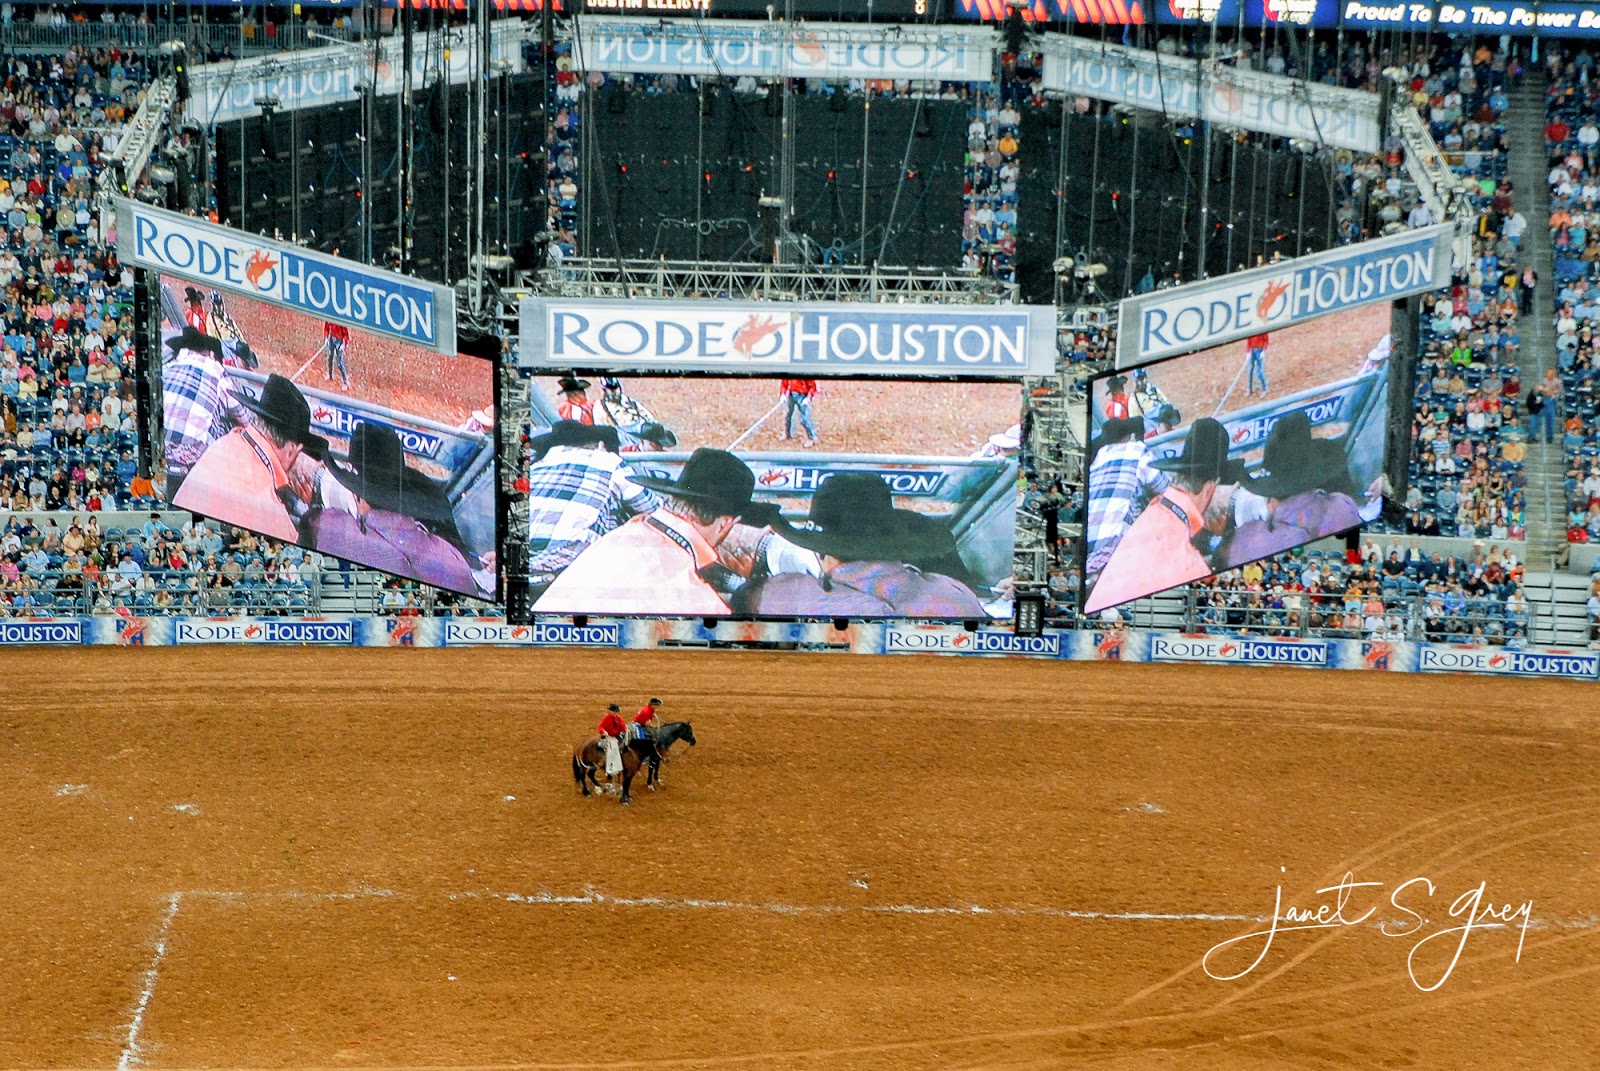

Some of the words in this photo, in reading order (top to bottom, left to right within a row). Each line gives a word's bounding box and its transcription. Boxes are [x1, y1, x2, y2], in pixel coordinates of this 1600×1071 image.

[1345, 2, 1405, 21] Proud
[1408, 4, 1432, 22] To
[1438, 6, 1466, 24] Be
[1471, 6, 1507, 25] The
[1509, 7, 1576, 27] Power
[1292, 248, 1434, 316] HOUSTON
[281, 254, 433, 339] HOUSTON
[794, 315, 1024, 363] HOUSTON
[266, 623, 350, 641] HOUSTON
[533, 624, 617, 643] HOUSTON
[973, 632, 1057, 653] HOUSTON
[1240, 642, 1324, 663] HOUSTON
[1510, 654, 1597, 675] HOUSTON
